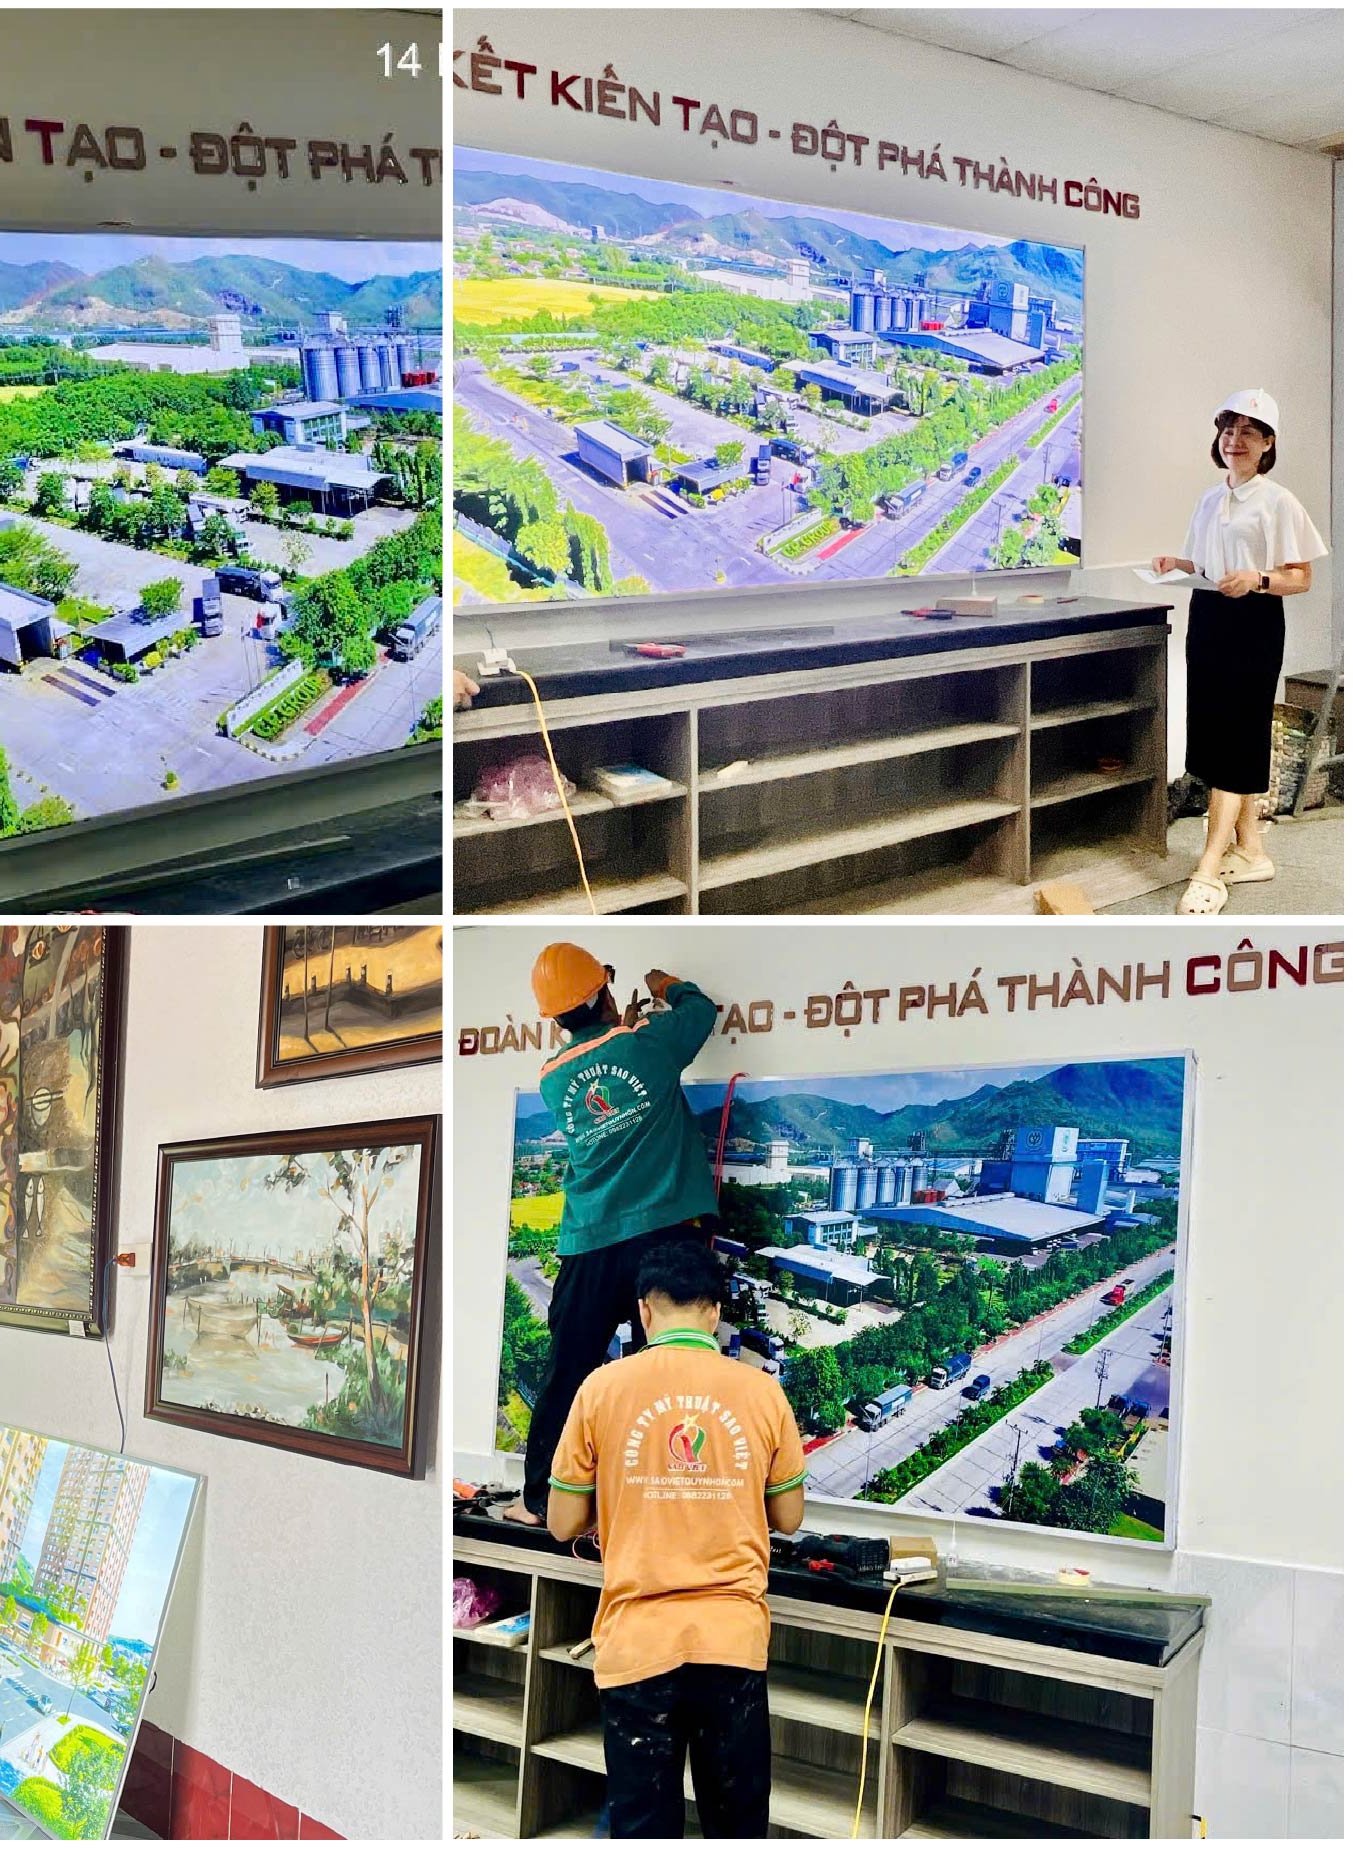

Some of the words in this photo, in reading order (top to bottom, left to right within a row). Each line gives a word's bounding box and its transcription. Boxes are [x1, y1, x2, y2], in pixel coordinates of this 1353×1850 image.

[25, 119, 146, 183] TẠO
[190, 121, 296, 191] ĐỘT
[307, 132, 408, 186] PHÁ
[552, 63, 660, 126] KIẾN
[672, 96, 758, 149] TẠO
[791, 120, 869, 172] ĐỘT
[878, 143, 947, 182] PHÁ
[952, 157, 1057, 204] THÀNH
[1064, 178, 1140, 219] CÔNG
[459, 1014, 541, 1056] ĐOÀN
[804, 980, 889, 1037] ĐỘT
[898, 967, 989, 1022] PHÁ
[997, 957, 1170, 1012] THÀNH
[1186, 938, 1344, 995] CÔNG
[611, 1065, 628, 1080] SAO
[719, 1410, 741, 1435] SAO
